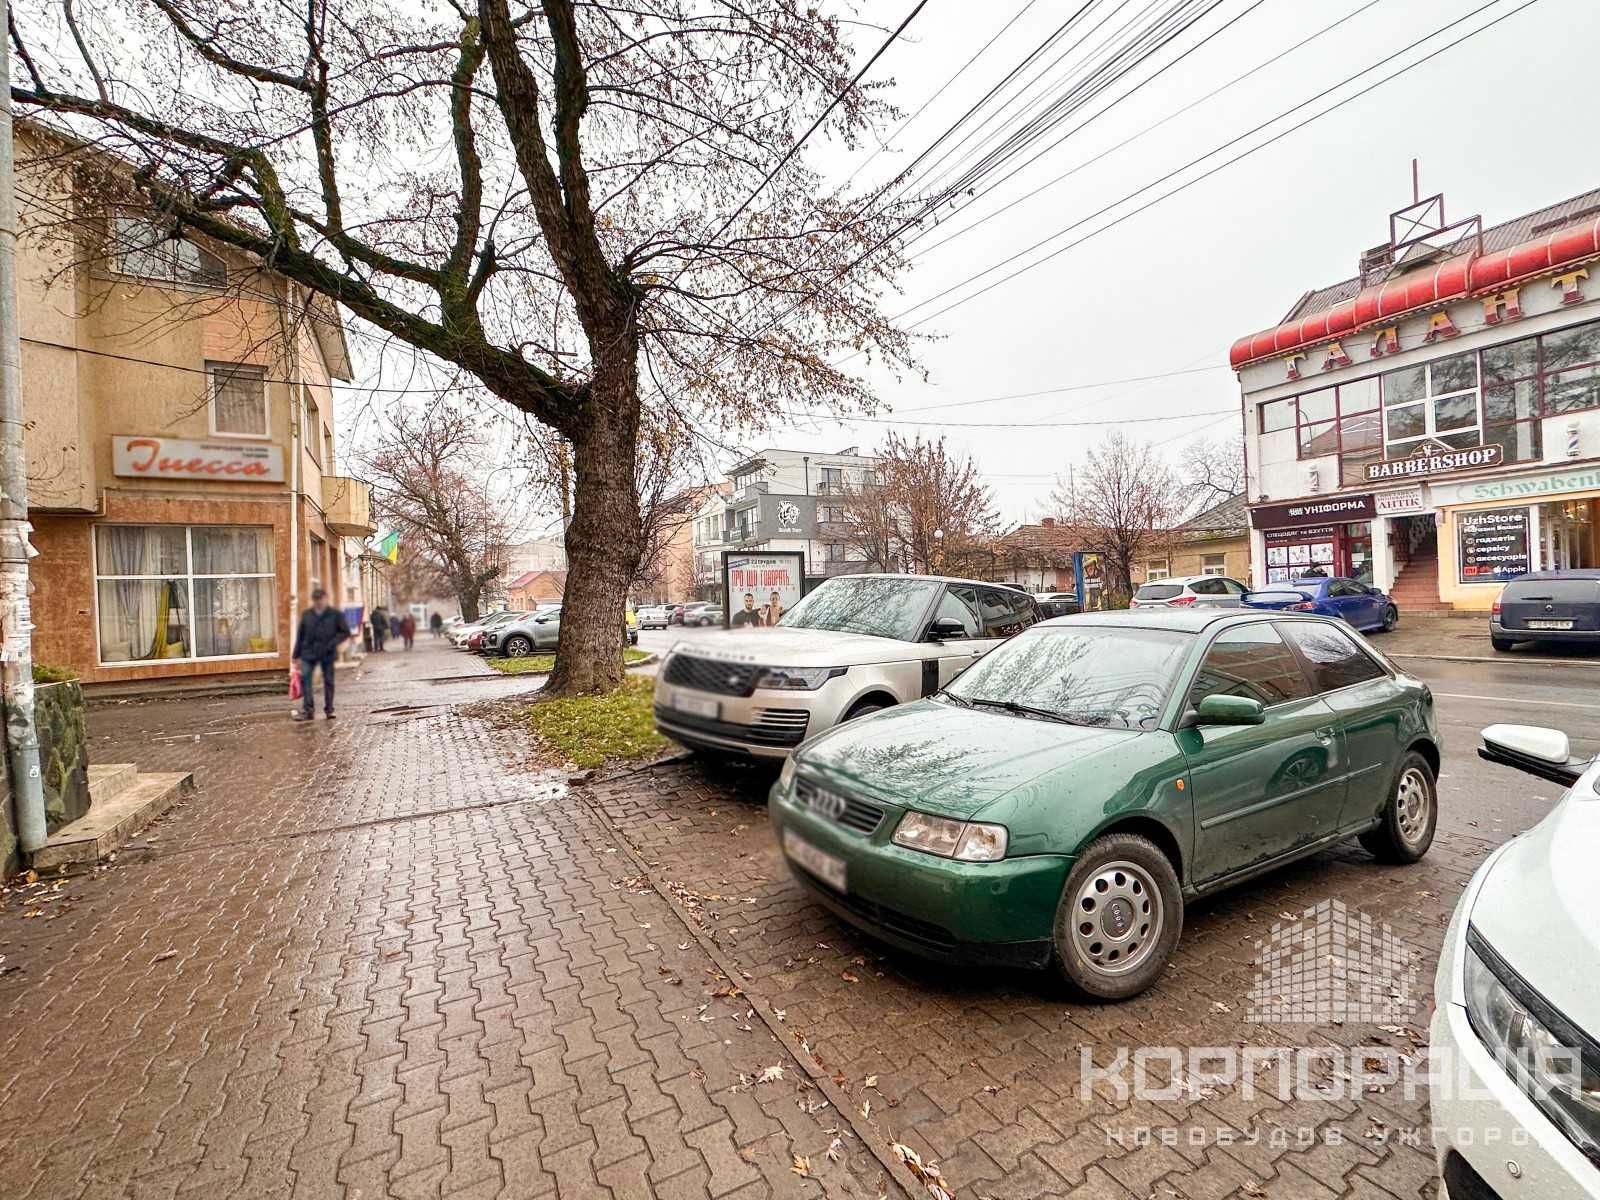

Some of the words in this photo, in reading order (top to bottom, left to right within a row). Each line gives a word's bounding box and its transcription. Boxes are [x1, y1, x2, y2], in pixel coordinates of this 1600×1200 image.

[1280, 268, 1590, 380] ТАЛАНТ
[1369, 448, 1496, 478] BARBERSHOP
[1304, 501, 1365, 515] УНІФОРМА
[1463, 514, 1523, 525] UzhStore
